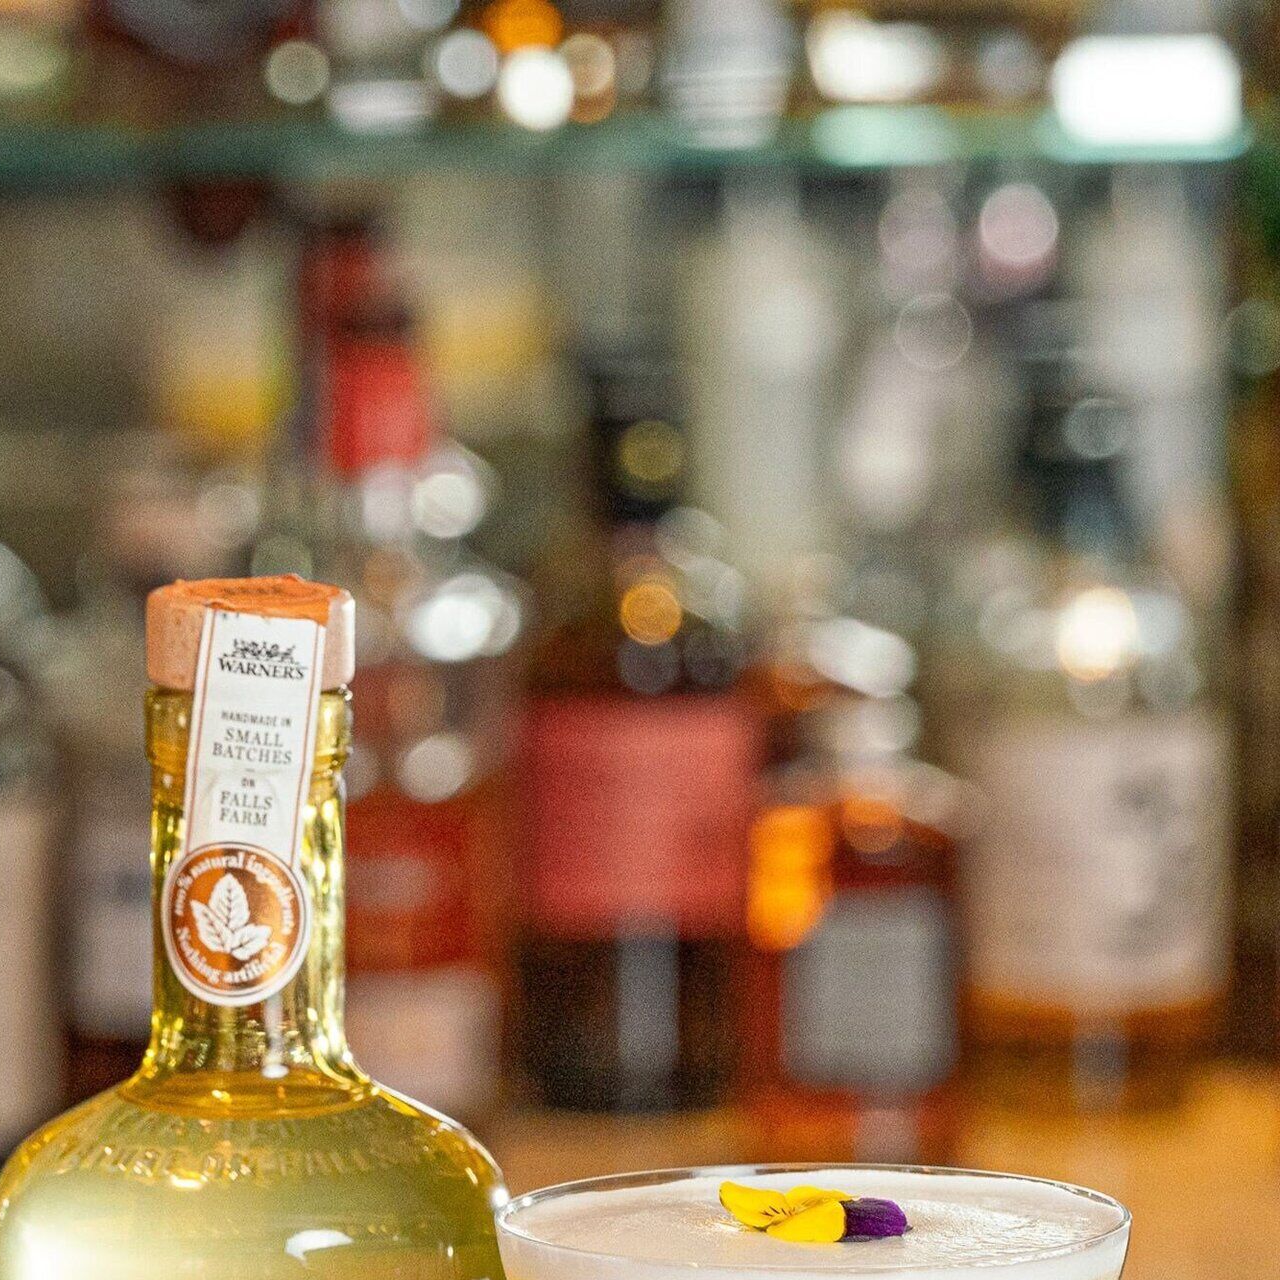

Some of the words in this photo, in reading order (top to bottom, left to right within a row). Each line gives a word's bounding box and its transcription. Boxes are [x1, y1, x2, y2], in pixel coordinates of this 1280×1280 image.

[221, 710, 277, 726] HANDMADE
[281, 717, 292, 727] IN
[225, 728, 284, 748] SMALL
[212, 742, 293, 765] BATCHES
[220, 791, 273, 811] FALLS
[219, 808, 268, 827] FARM
[176, 926, 221, 984] Nothing
